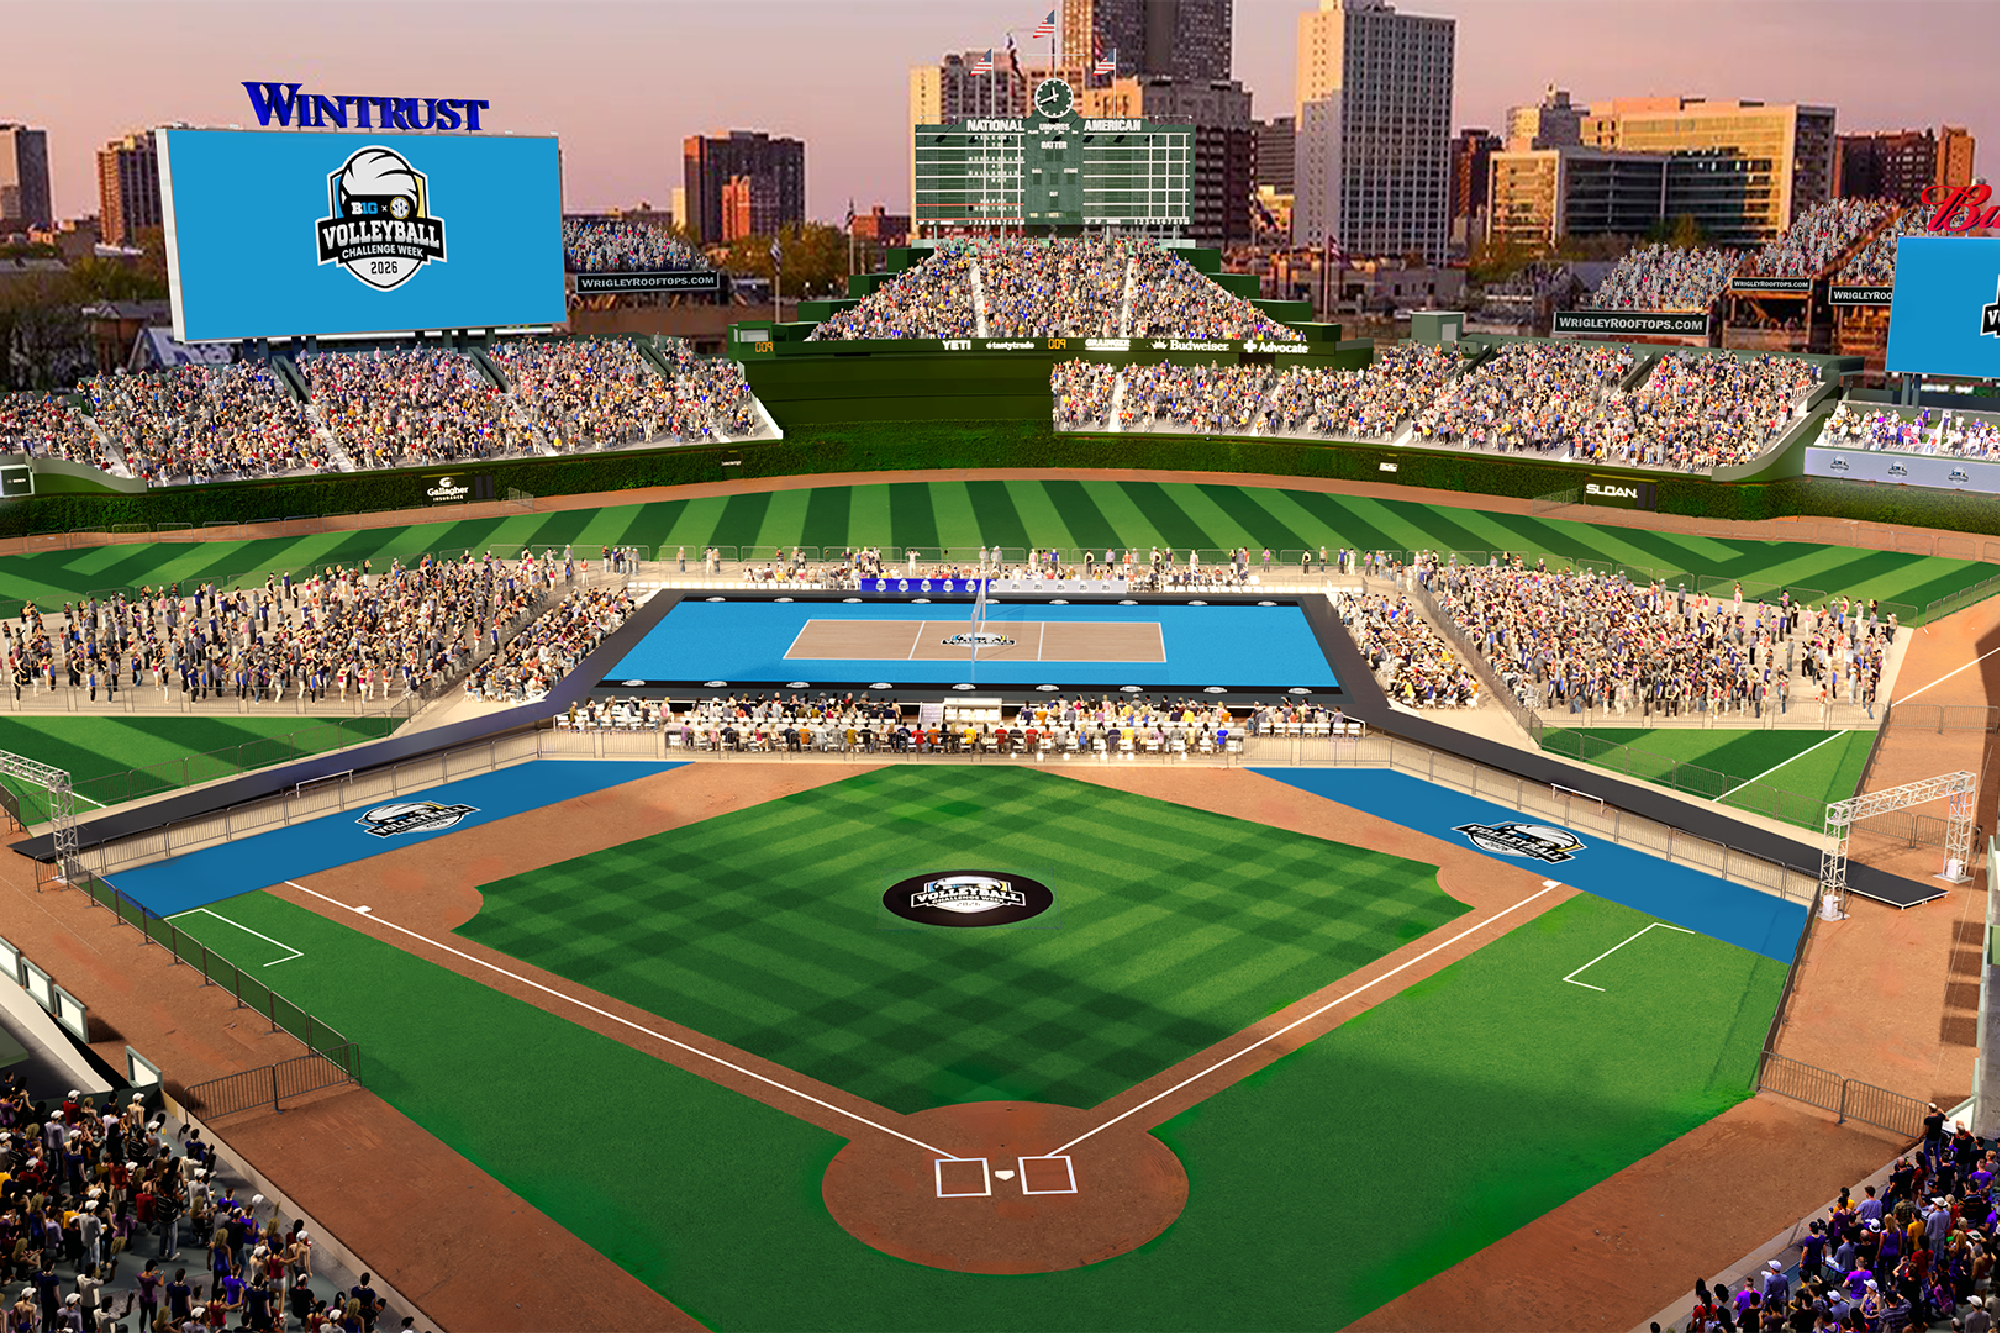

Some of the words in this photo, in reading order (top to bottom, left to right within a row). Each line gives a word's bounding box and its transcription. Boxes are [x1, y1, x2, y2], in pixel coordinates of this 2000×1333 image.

[241, 82, 489, 131] WINTRUST
[967, 119, 1024, 131] NATIONAL
[1084, 119, 1142, 131] AMERICAN
[322, 220, 440, 250] VOLLEYBALL
[342, 244, 396, 259] CHALLENGE
[397, 244, 424, 258] WEEK
[370, 261, 398, 274] 2026
[581, 276, 714, 288] WRIGLEYROOFTOPS.COM
[1559, 317, 1703, 330] WRIGLEYROOFTOPS.COM
[942, 340, 971, 350] YETI
[1169, 340, 1229, 351] Budweiser
[1258, 341, 1309, 353] Advocate
[427, 487, 469, 495] Gallagher
[1586, 483, 1638, 498] SLOAN
[916, 887, 1021, 903] VOLLEYBALL
